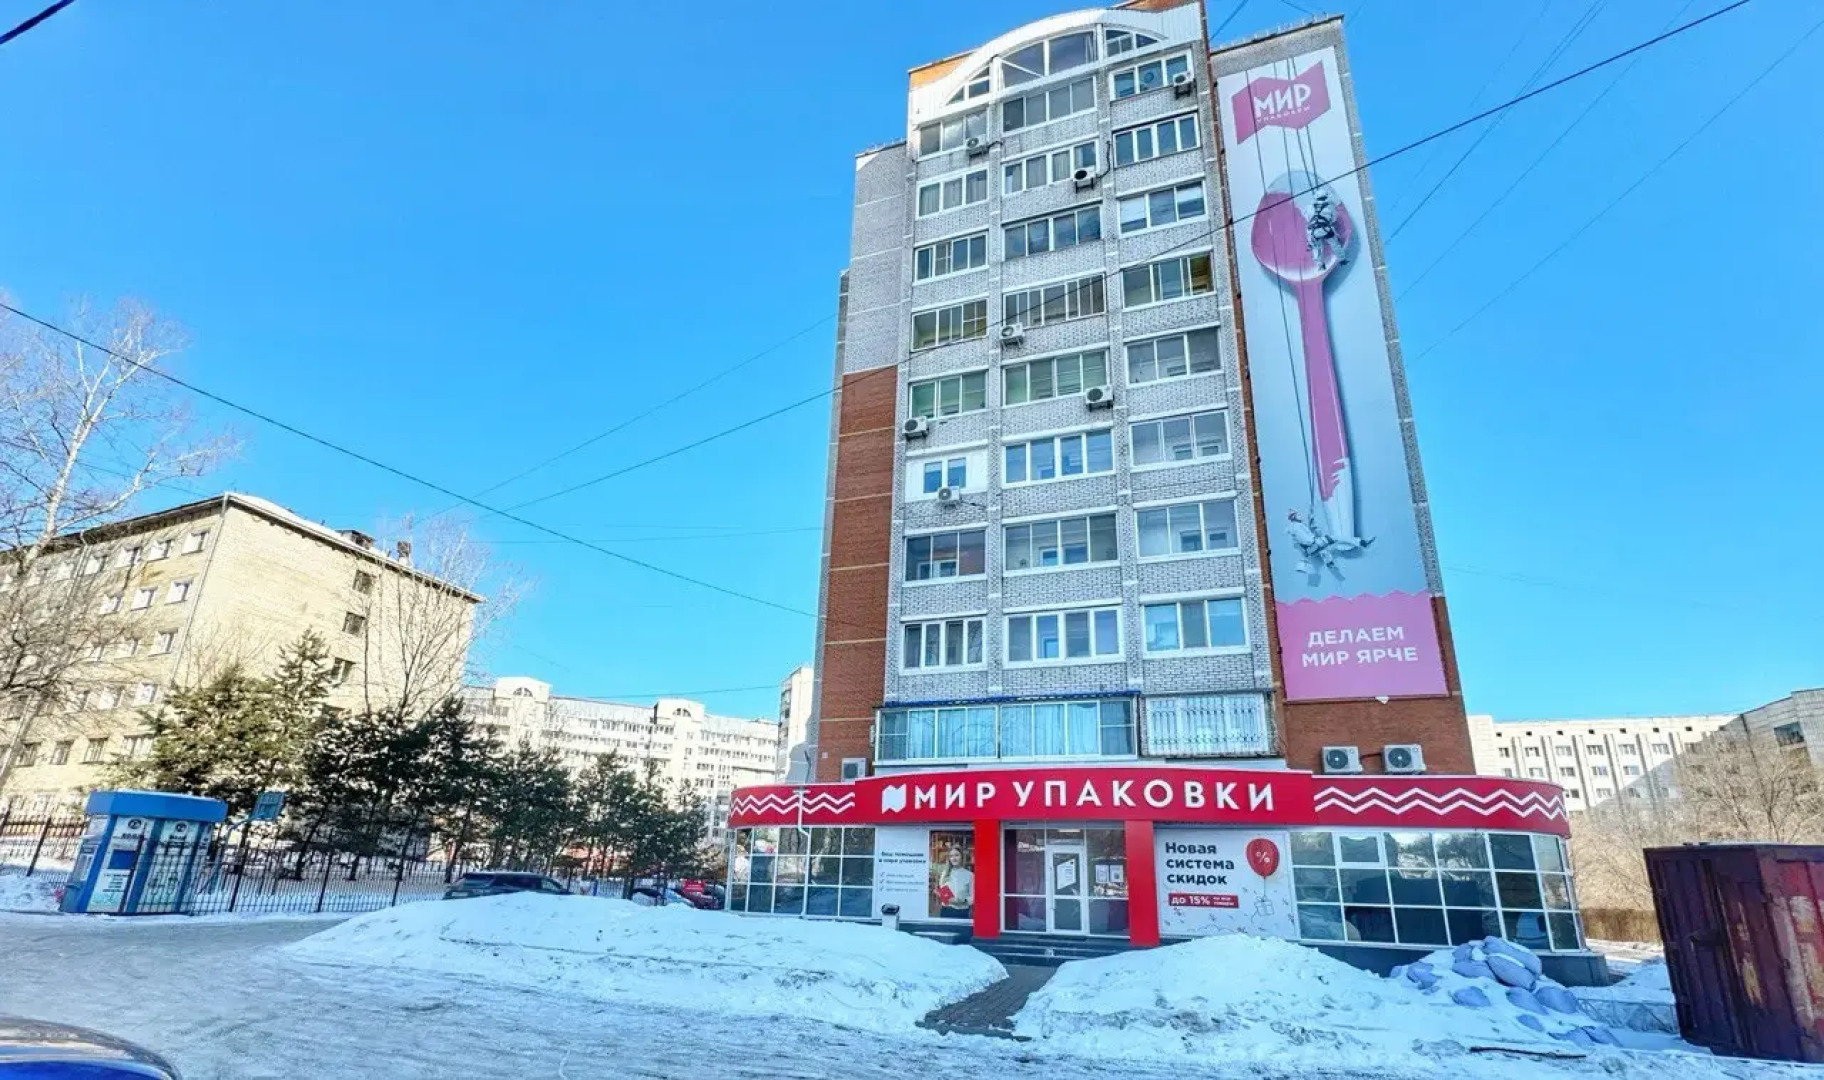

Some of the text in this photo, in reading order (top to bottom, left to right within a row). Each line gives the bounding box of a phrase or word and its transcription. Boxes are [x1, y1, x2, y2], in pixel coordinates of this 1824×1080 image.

[1253, 83, 1311, 119] МИР
[1308, 626, 1404, 648] ДЕЛАЕМ
[1302, 646, 1419, 668] МИР ЯРЧЕ
[914, 779, 1274, 812] МИР УПАКОВКИ
[1165, 842, 1217, 854] Новая
[1166, 859, 1235, 870] система
[1166, 874, 1227, 885] скидок
[1172, 895, 1211, 906] до 15%
